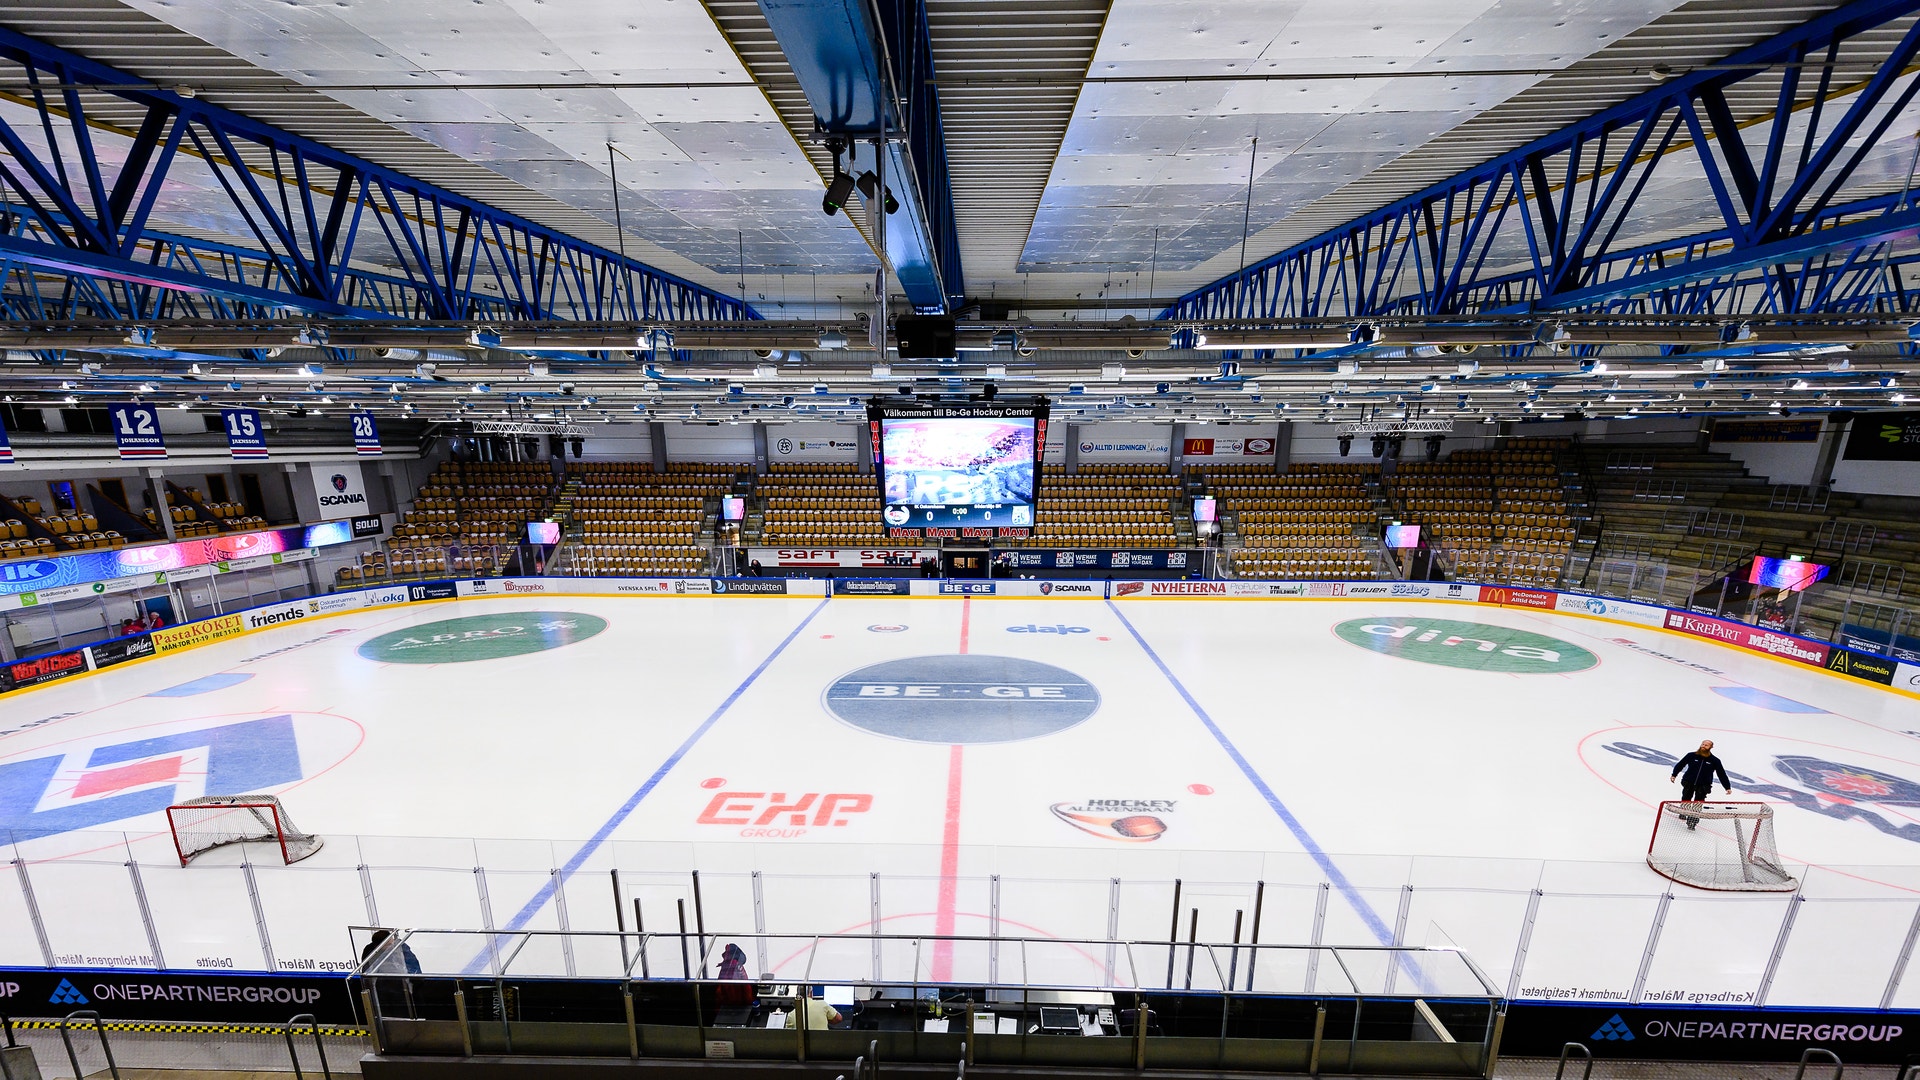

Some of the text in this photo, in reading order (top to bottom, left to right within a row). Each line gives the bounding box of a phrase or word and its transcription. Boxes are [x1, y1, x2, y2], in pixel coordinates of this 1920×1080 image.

[884, 408, 1033, 418] Välkommen till Be-Ge Hockey Center
[116, 409, 155, 435] 12
[227, 413, 256, 436] 15
[354, 416, 373, 437] 28
[870, 421, 880, 463] MAXI
[1037, 419, 1046, 462] MAXI
[320, 494, 366, 506] SCANIA
[926, 511, 934, 521] 0
[984, 511, 992, 520] 0
[355, 518, 379, 530] SOLID
[890, 528, 1029, 537] MAXI MAXI MAXI MAXI
[130, 548, 159, 562] IK
[5, 562, 42, 581] IK
[412, 586, 426, 599] OT
[728, 580, 782, 591] Lindbytvätten
[1151, 582, 1226, 593] NYHETERNA
[1332, 583, 1347, 596] EL
[1391, 584, 1430, 596] Söders
[320, 596, 356, 606] Oskarshamns
[382, 593, 405, 603] okg
[320, 602, 346, 610] kommun
[250, 608, 305, 628] friends
[153, 613, 242, 646] PastaKÖKET
[1006, 624, 1092, 635] elajo
[162, 638, 191, 652] MÅN-TOR
[192, 634, 209, 644] 11-19
[224, 627, 240, 636] 11-15
[1359, 624, 1560, 663] dina
[1764, 633, 1795, 647] Stads
[1748, 634, 1822, 662] Magasinet
[1848, 643, 1867, 652] METALL
[12, 658, 50, 680] World
[50, 652, 82, 671] Class
[1853, 661, 1890, 676] Assemblin
[696, 792, 874, 826] EXP
[739, 828, 808, 838] GROUP
[94, 984, 321, 1004] ONEPARTNERGROUP
[1645, 1020, 1902, 1042] ONEPARTNERGROUP
